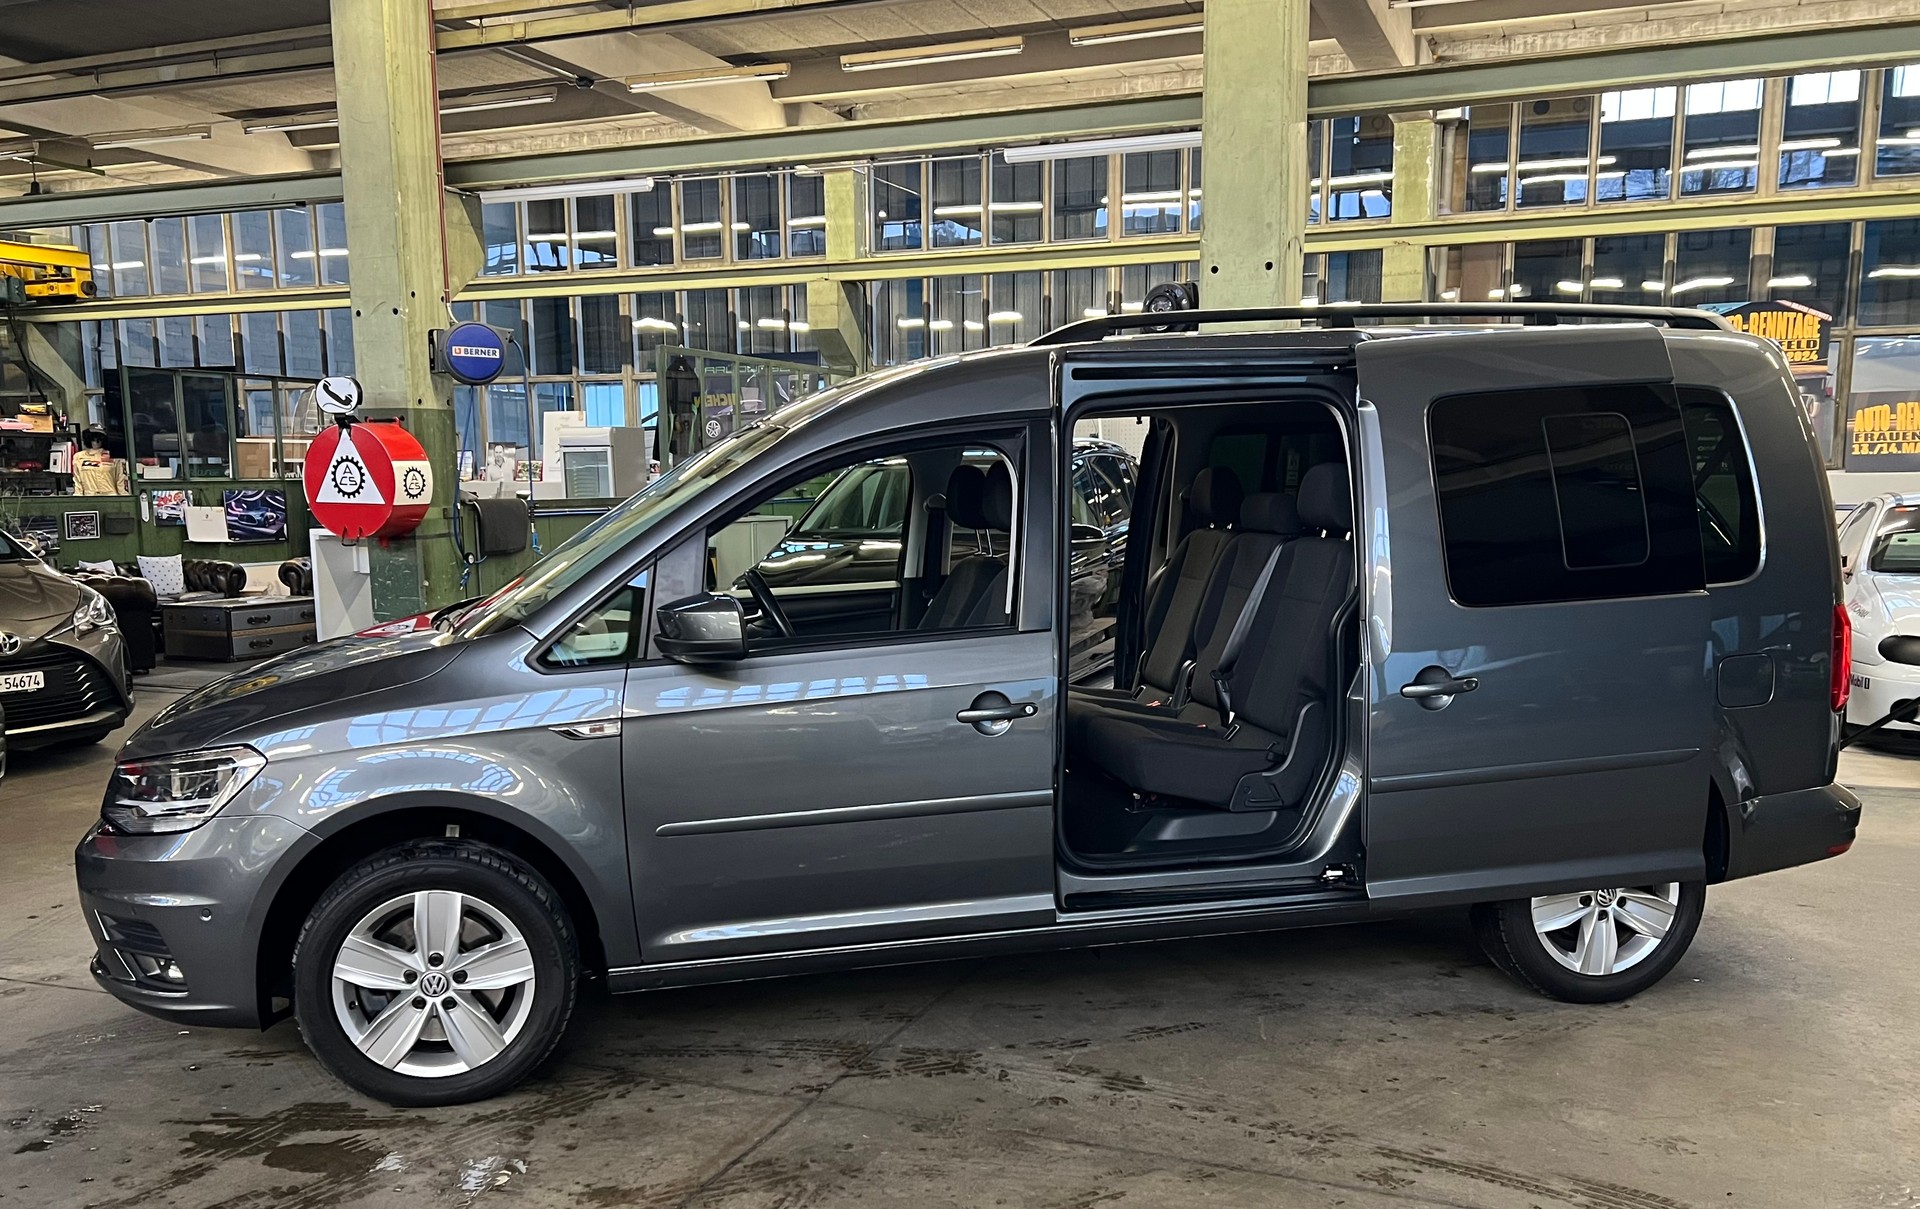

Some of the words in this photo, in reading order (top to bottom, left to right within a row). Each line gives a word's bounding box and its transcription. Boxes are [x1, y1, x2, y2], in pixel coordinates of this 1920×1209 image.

[463, 347, 498, 357] BERNER
[1787, 350, 1818, 361] 2024
[1855, 432, 1920, 442] FRAUEN
[4, 675, 40, 689] 54674
